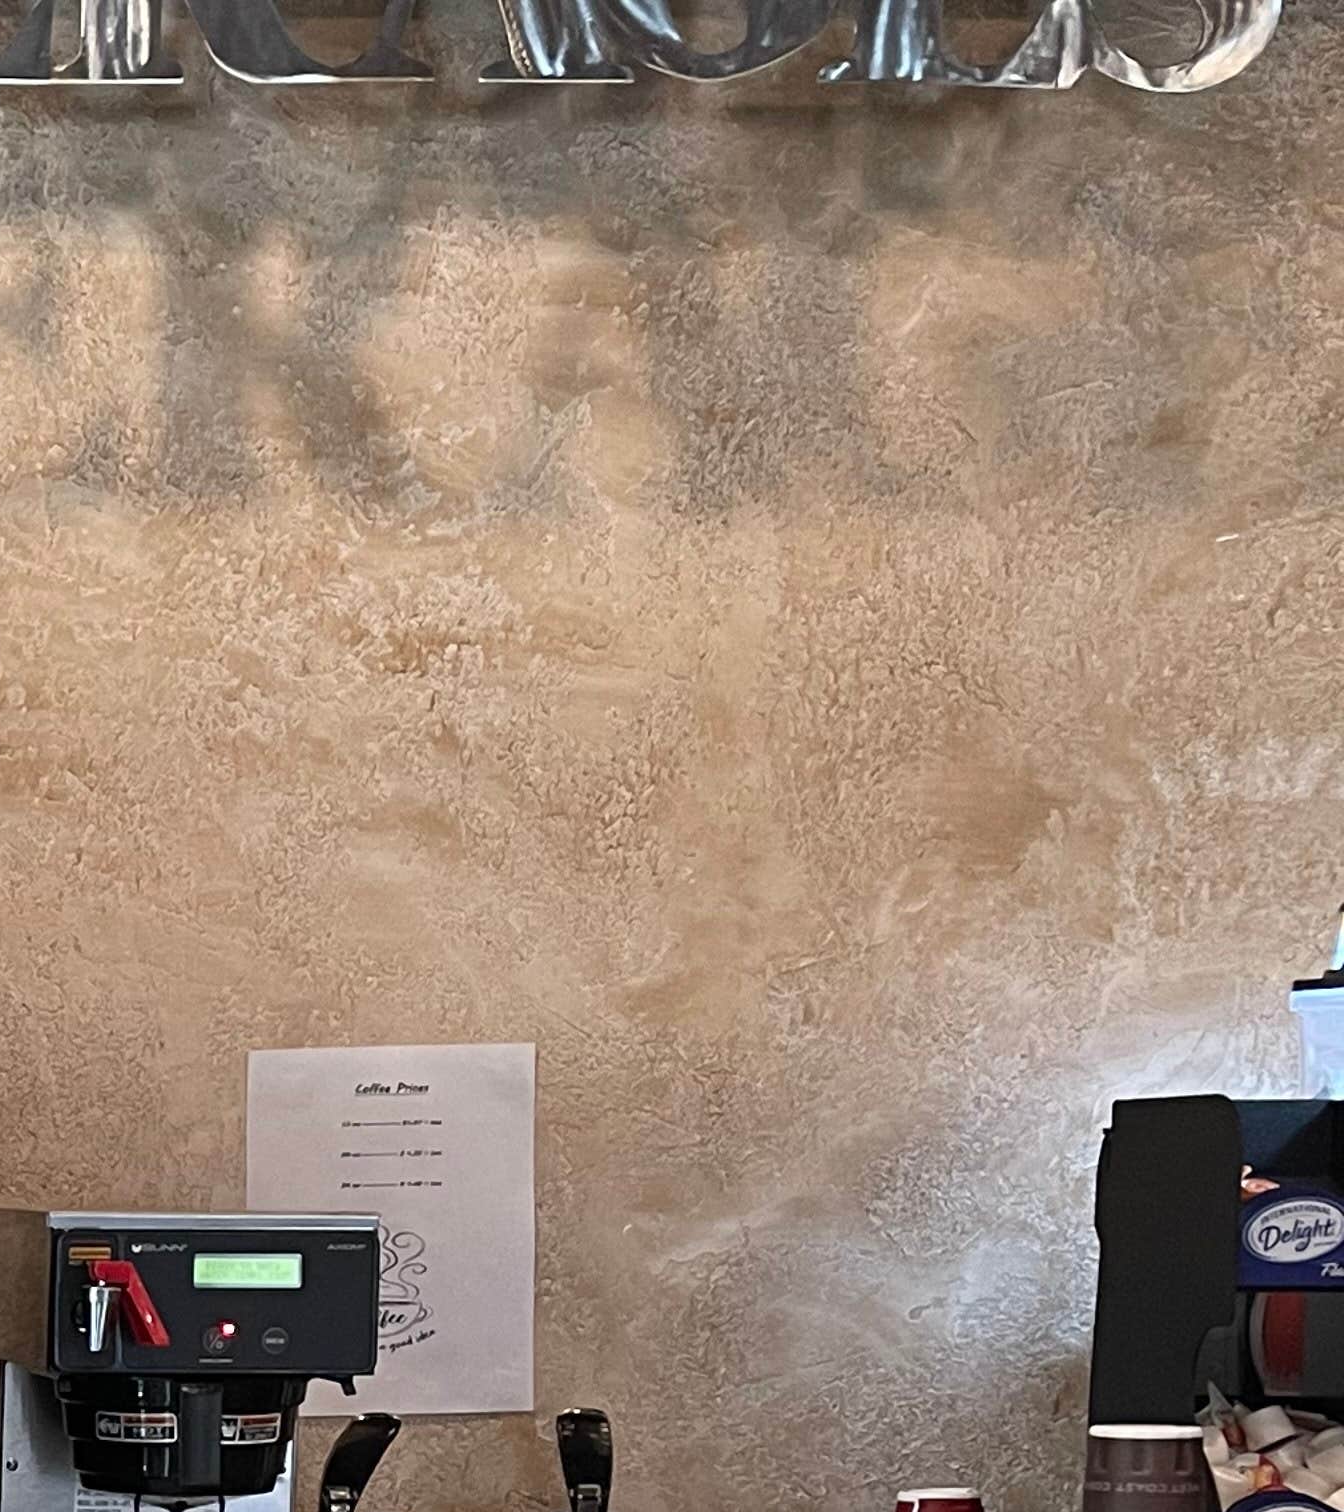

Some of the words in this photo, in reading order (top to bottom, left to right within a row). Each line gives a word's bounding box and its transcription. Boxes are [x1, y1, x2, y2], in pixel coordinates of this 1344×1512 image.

[355, 1083, 391, 1094] Coffee
[397, 1082, 429, 1094] Prices
[1258, 1218, 1336, 1252] Delight
